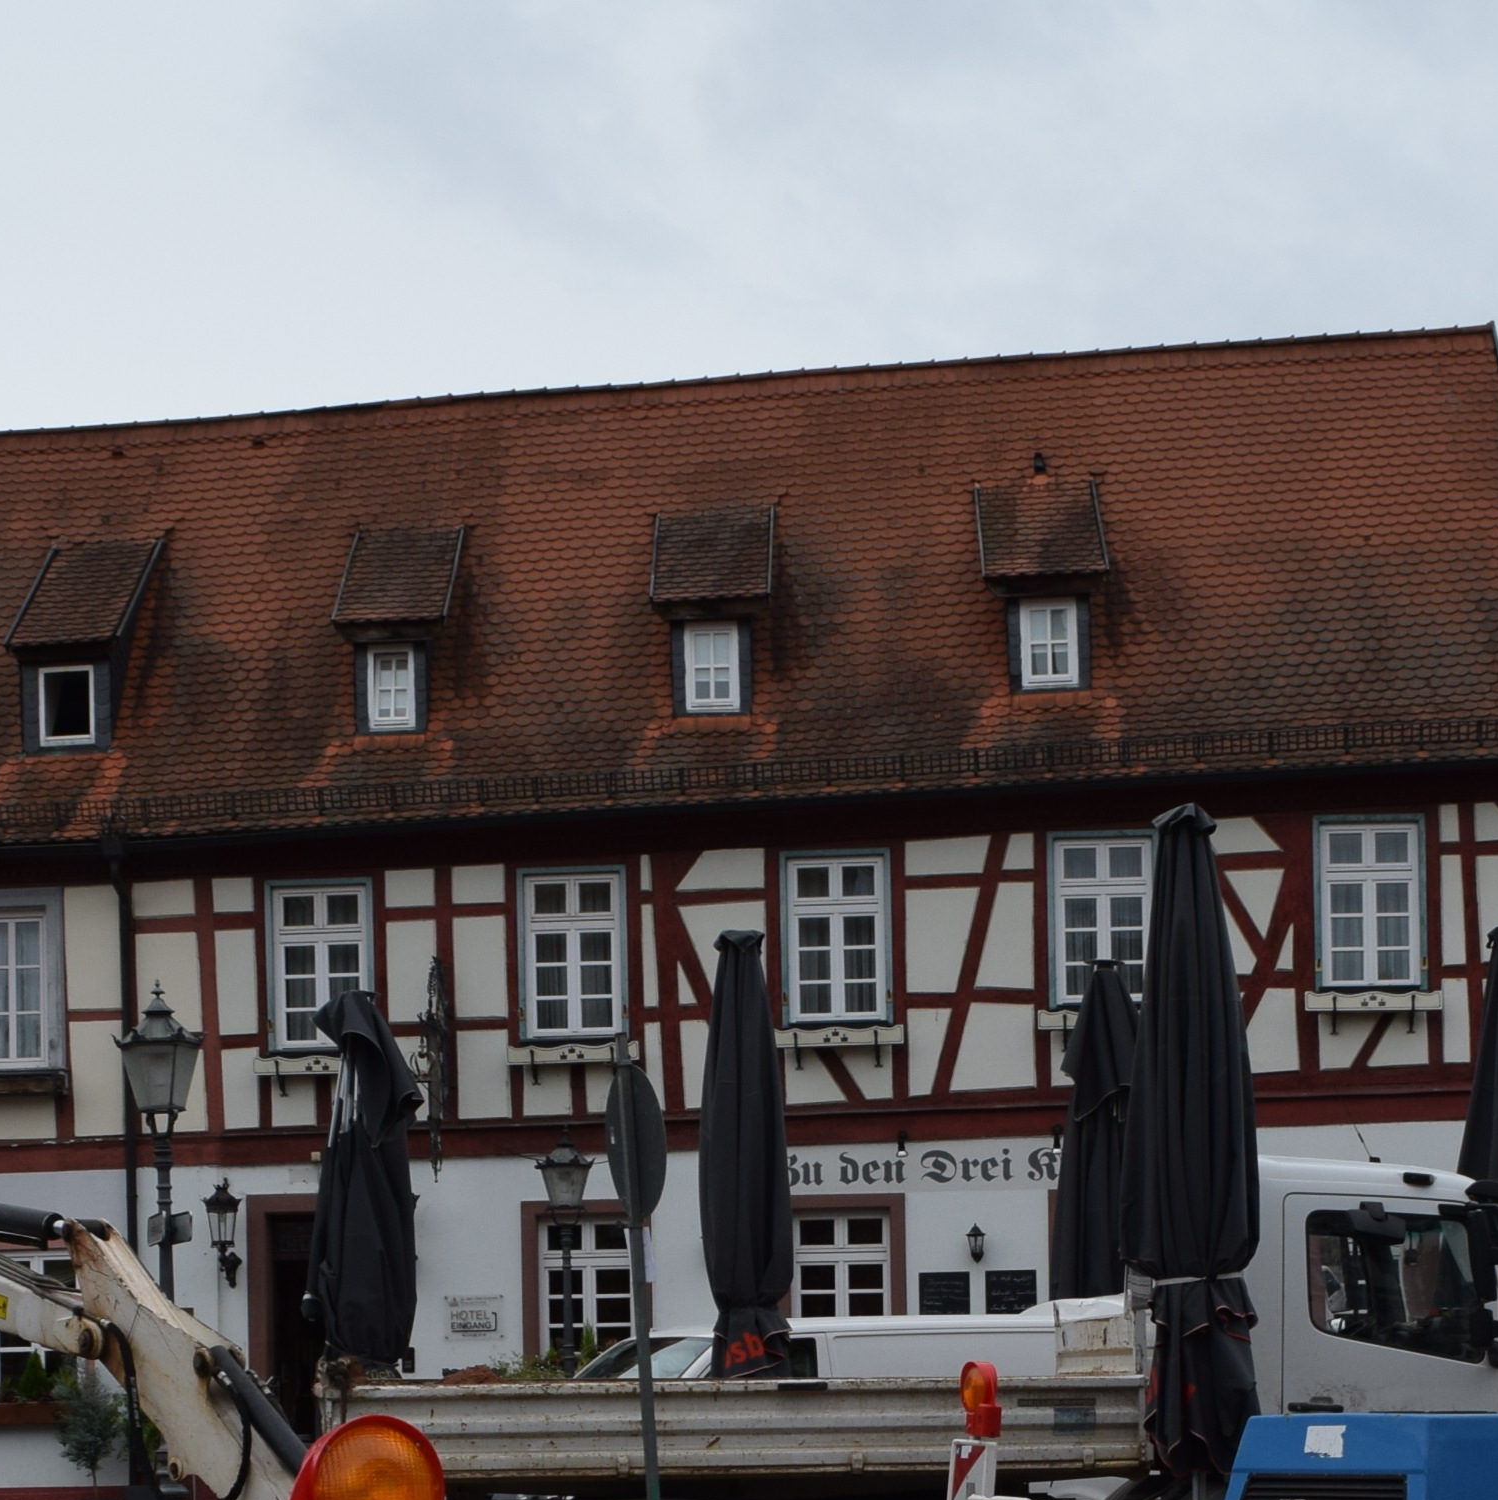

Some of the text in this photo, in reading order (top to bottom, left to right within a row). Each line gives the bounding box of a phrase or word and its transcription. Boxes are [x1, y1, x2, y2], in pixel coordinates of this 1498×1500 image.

[838, 1151, 906, 1186] den
[920, 1149, 1013, 1184] Drei
[451, 1310, 490, 1321] HOTEL
[451, 1321, 492, 1330] EINGANG
